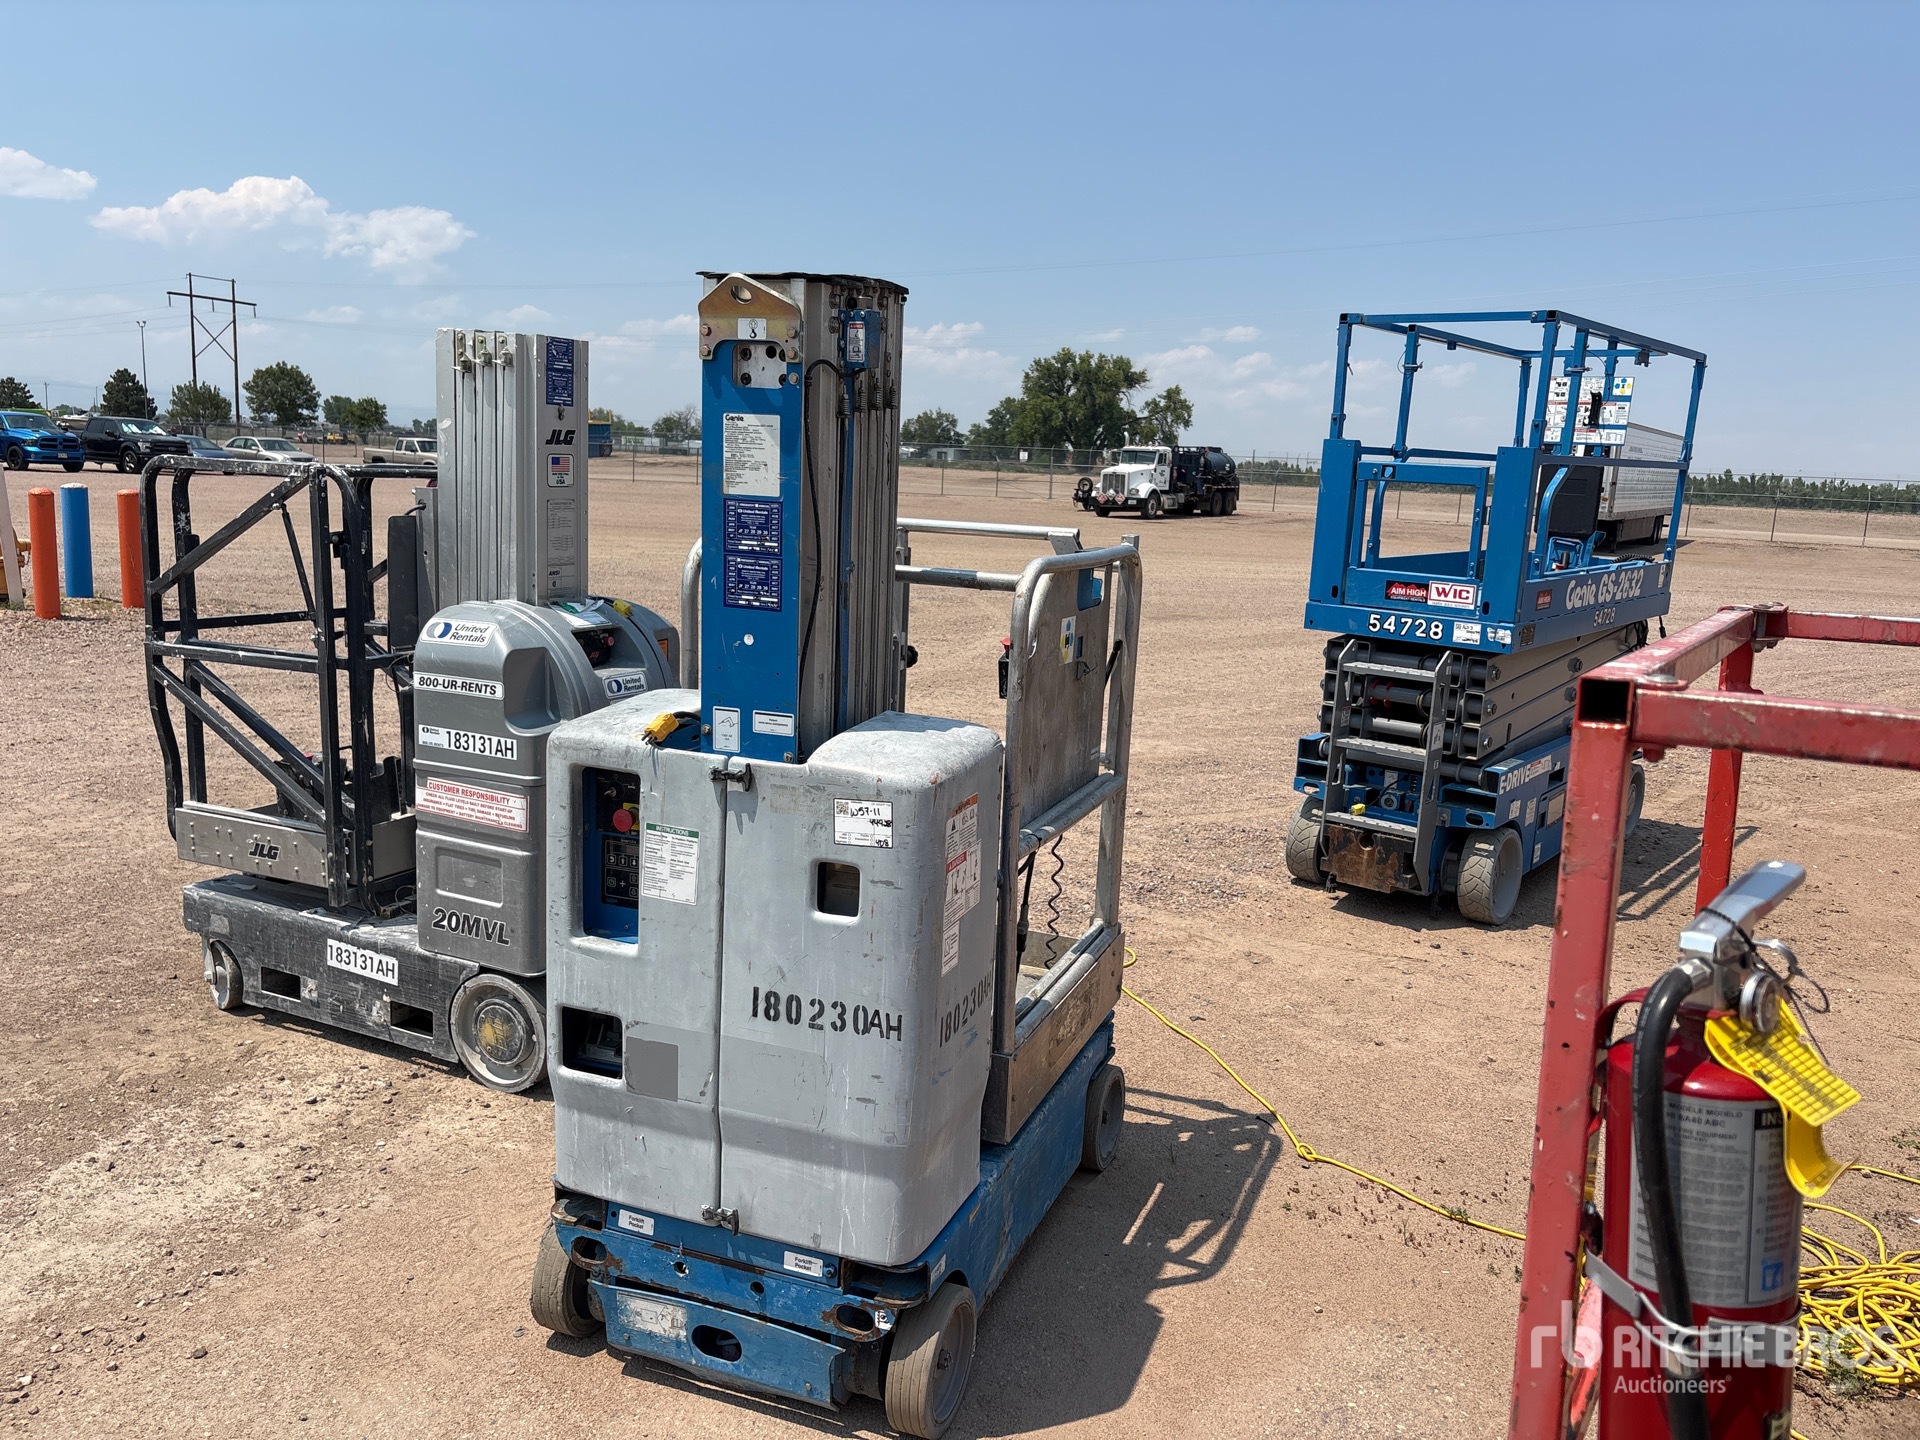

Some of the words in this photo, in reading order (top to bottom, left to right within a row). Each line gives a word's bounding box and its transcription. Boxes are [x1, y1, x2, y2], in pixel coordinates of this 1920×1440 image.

[545, 429, 576, 446] JLG
[1391, 587, 1405, 595] AIM
[1407, 588, 1426, 597] HIGH
[1434, 585, 1470, 600] WIC
[1565, 579, 1596, 610] Genie
[1598, 569, 1644, 603] GS-2632
[1593, 607, 1616, 627] 54728
[455, 623, 490, 634] United
[1368, 613, 1443, 640] 54728
[450, 632, 486, 643] Rentals
[418, 676, 497, 695] 800-UR-RENTS
[622, 676, 642, 686] United
[624, 683, 644, 692] Rentals
[446, 731, 514, 758] 183131AH
[429, 782, 460, 794] CUSTOMER
[461, 789, 510, 805] RESPONSIBILITY
[656, 826, 689, 836] INSTRUCTIONS
[249, 843, 280, 860] JLG
[432, 907, 511, 946] 20MVL
[328, 944, 395, 979] 183131AH
[752, 986, 903, 1041] 180230AH
[629, 1215, 645, 1224] Forklift
[629, 1221, 643, 1229] Pocket
[795, 1263, 811, 1271] Pocket
